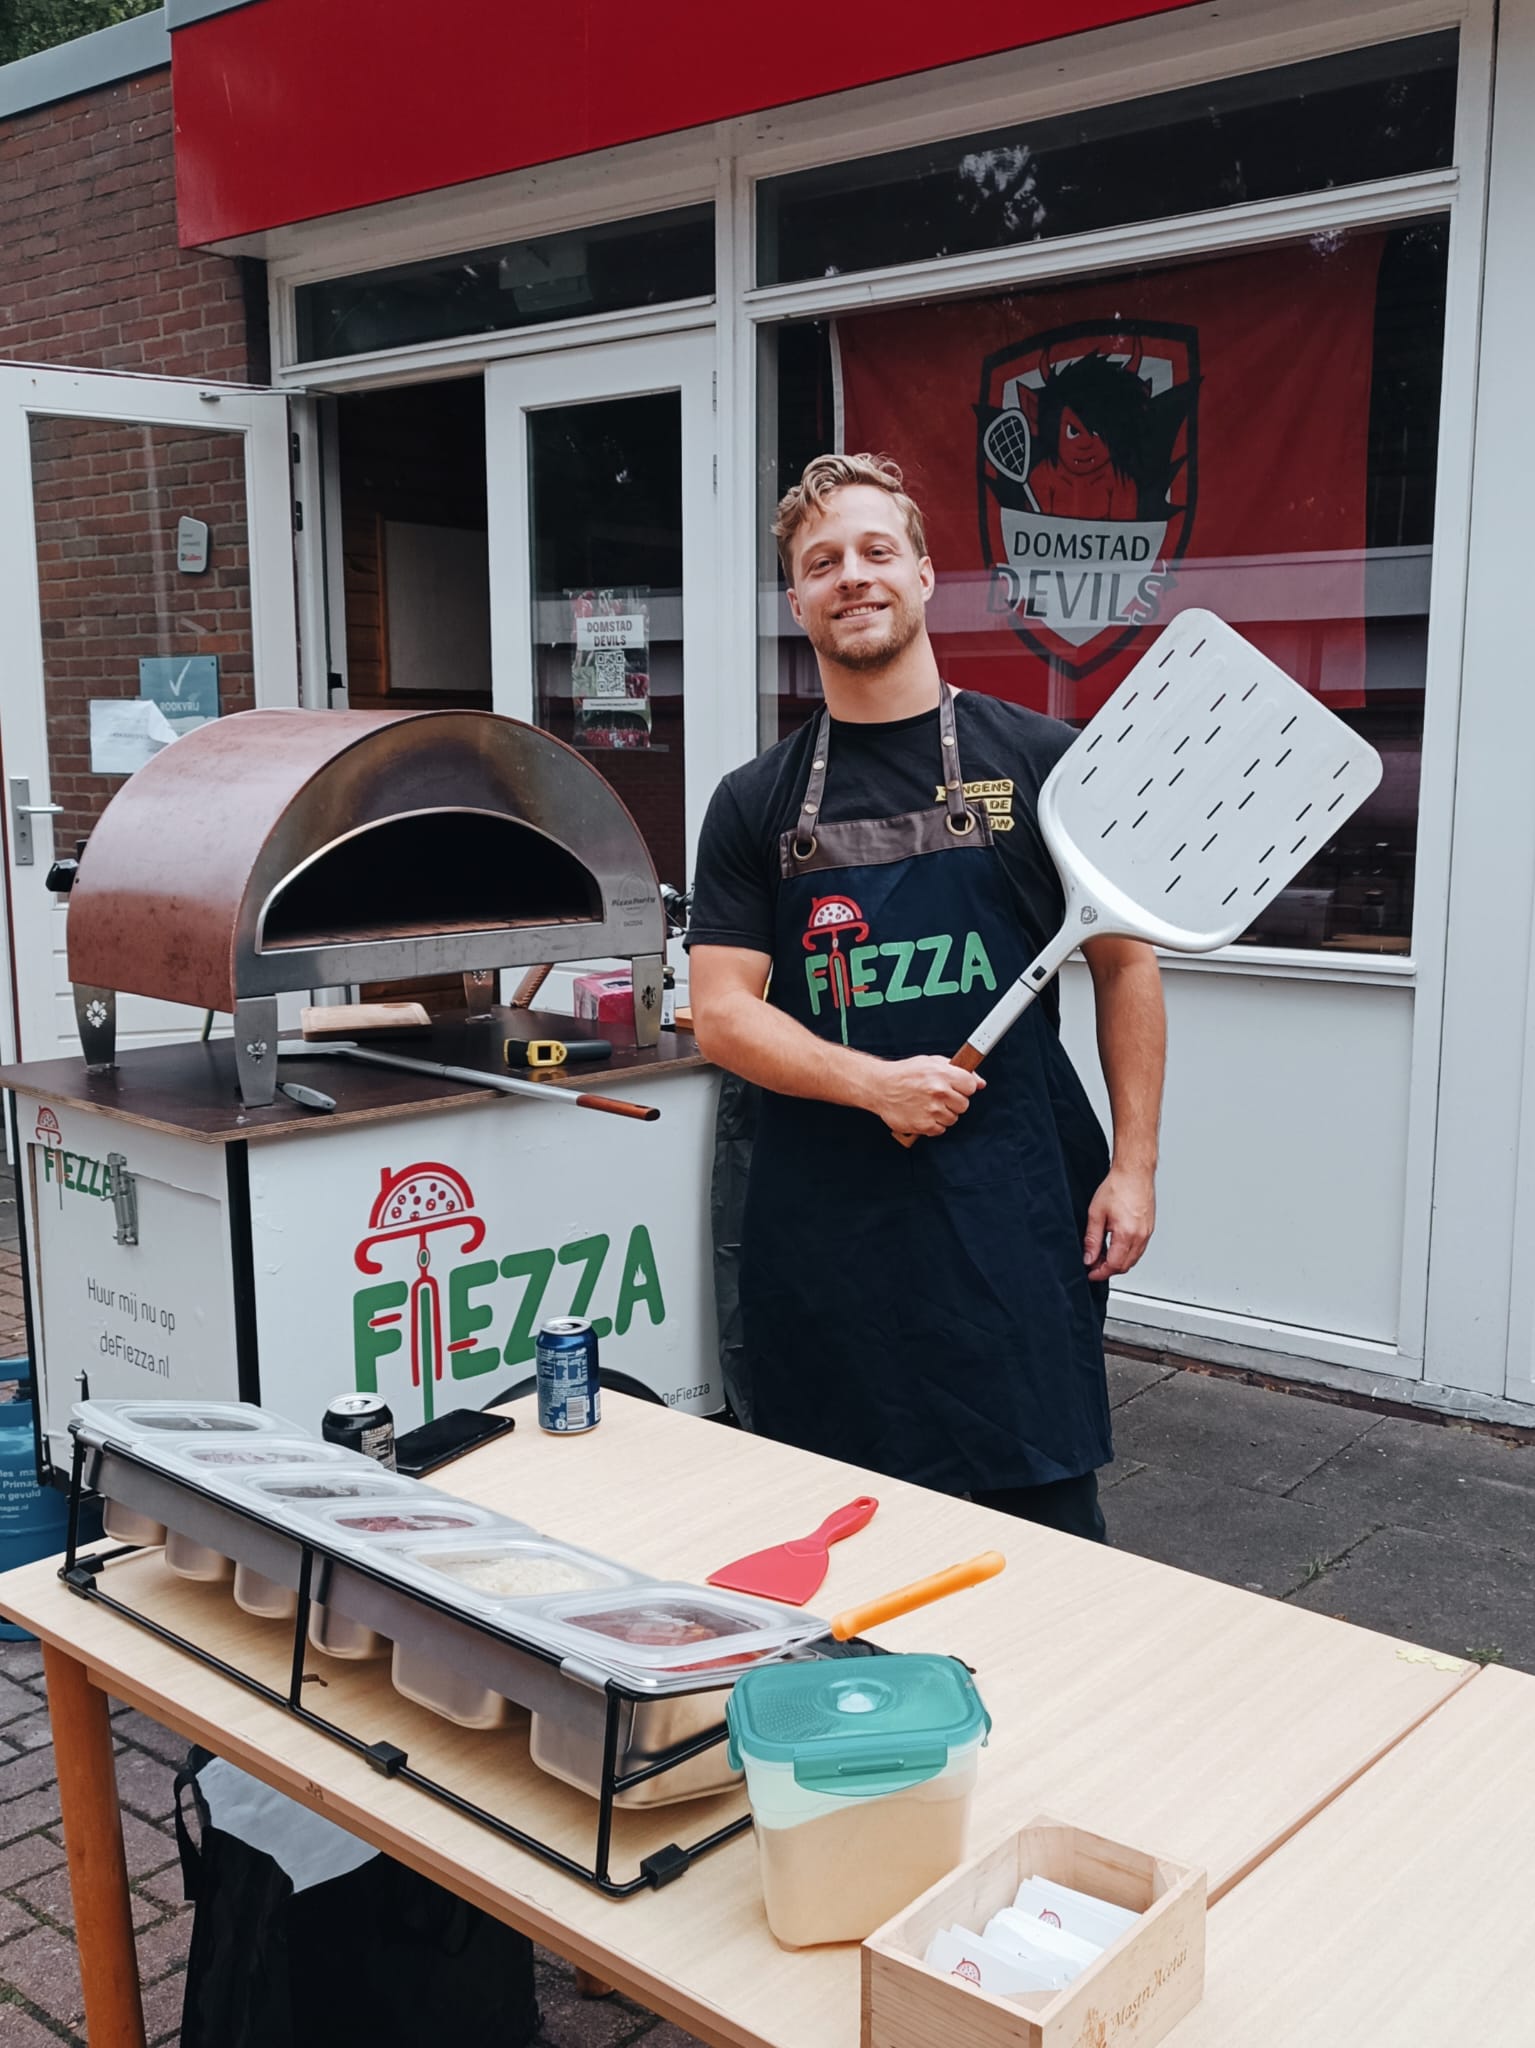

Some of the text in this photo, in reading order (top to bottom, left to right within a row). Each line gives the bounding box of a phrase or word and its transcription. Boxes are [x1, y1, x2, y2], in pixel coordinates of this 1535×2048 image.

[1013, 530, 1150, 562] DOMSTAD
[986, 564, 1164, 624] DEVILS
[586, 620, 633, 633] DOMSTAD
[593, 634, 627, 647] DEVILS
[941, 781, 1011, 799] NGENS
[989, 800, 1009, 810] DE
[87, 1276, 176, 1336] Huur mij nu op
[99, 1330, 170, 1379] deFiezza.nl
[662, 1383, 711, 1406] DeFiezza
[2, 1479, 40, 1489] Primag
[8, 1488, 42, 1502] gevuld
